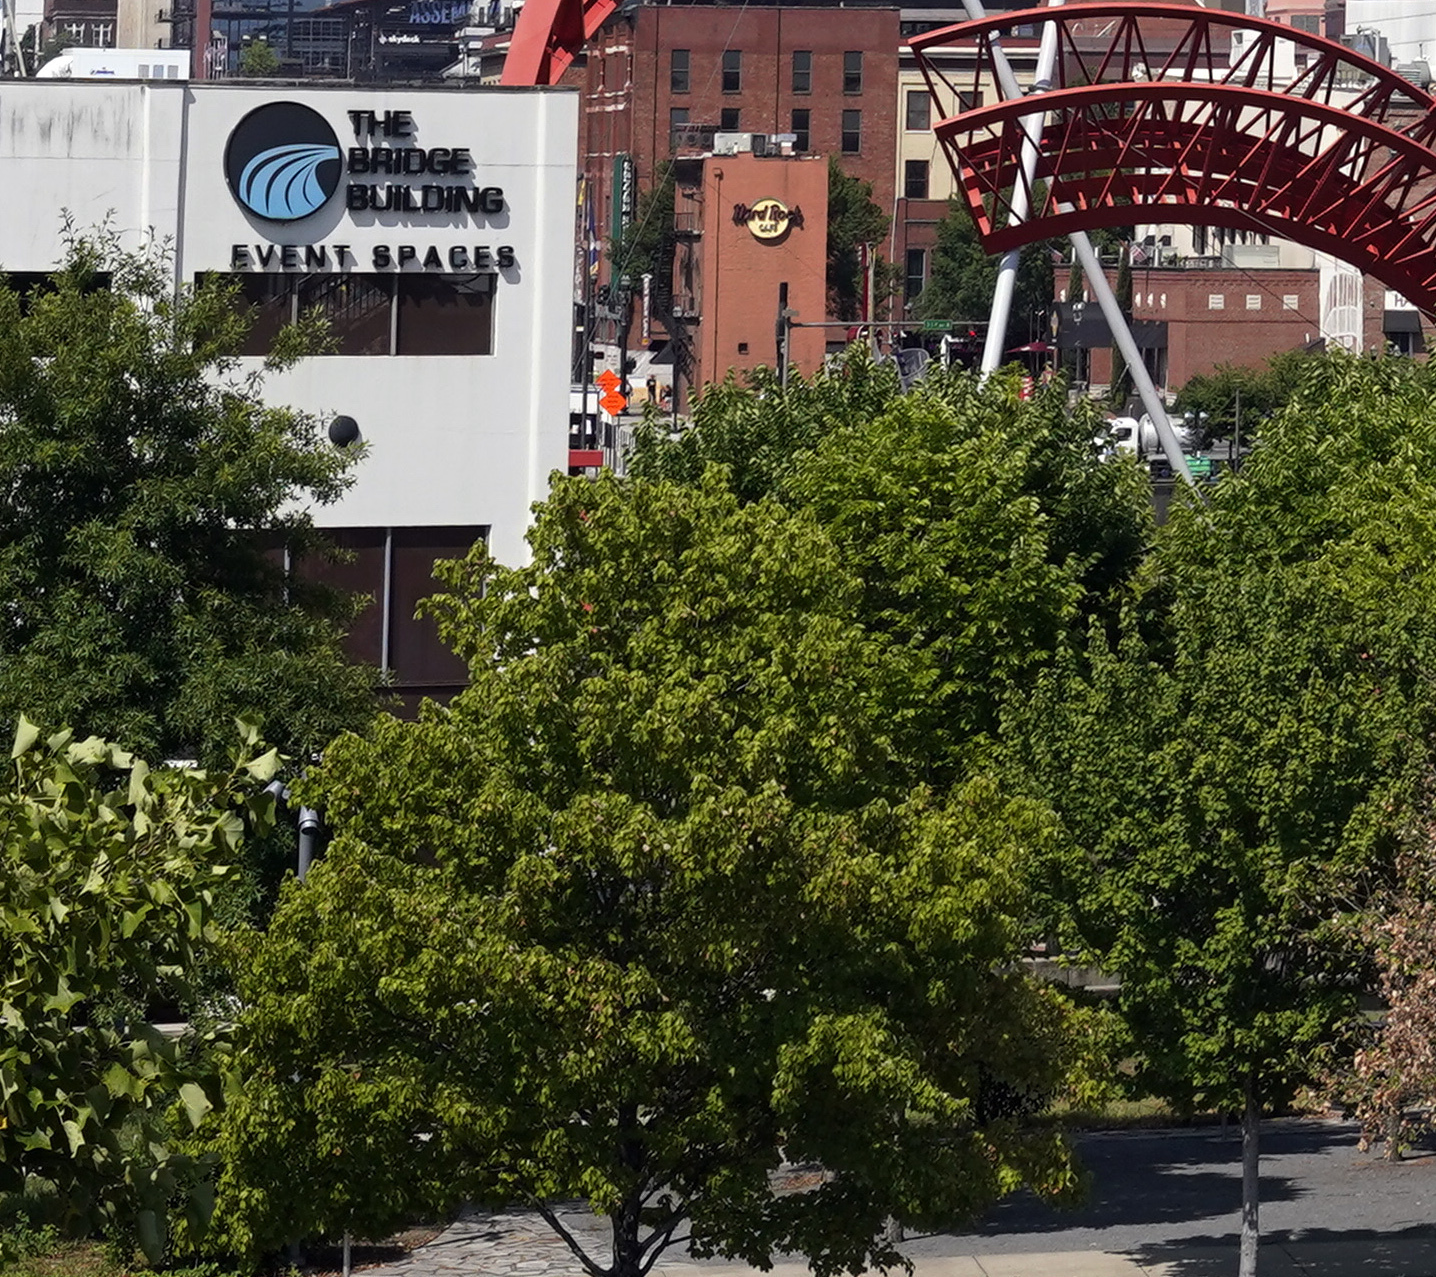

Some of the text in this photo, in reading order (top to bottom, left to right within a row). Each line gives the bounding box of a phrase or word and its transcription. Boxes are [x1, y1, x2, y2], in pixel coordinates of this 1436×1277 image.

[347, 110, 412, 136] THE
[347, 147, 470, 175] BRIDGE
[346, 184, 503, 213] BUILDING
[733, 203, 768, 226] Hard
[231, 245, 516, 268] EVENT SPACES
